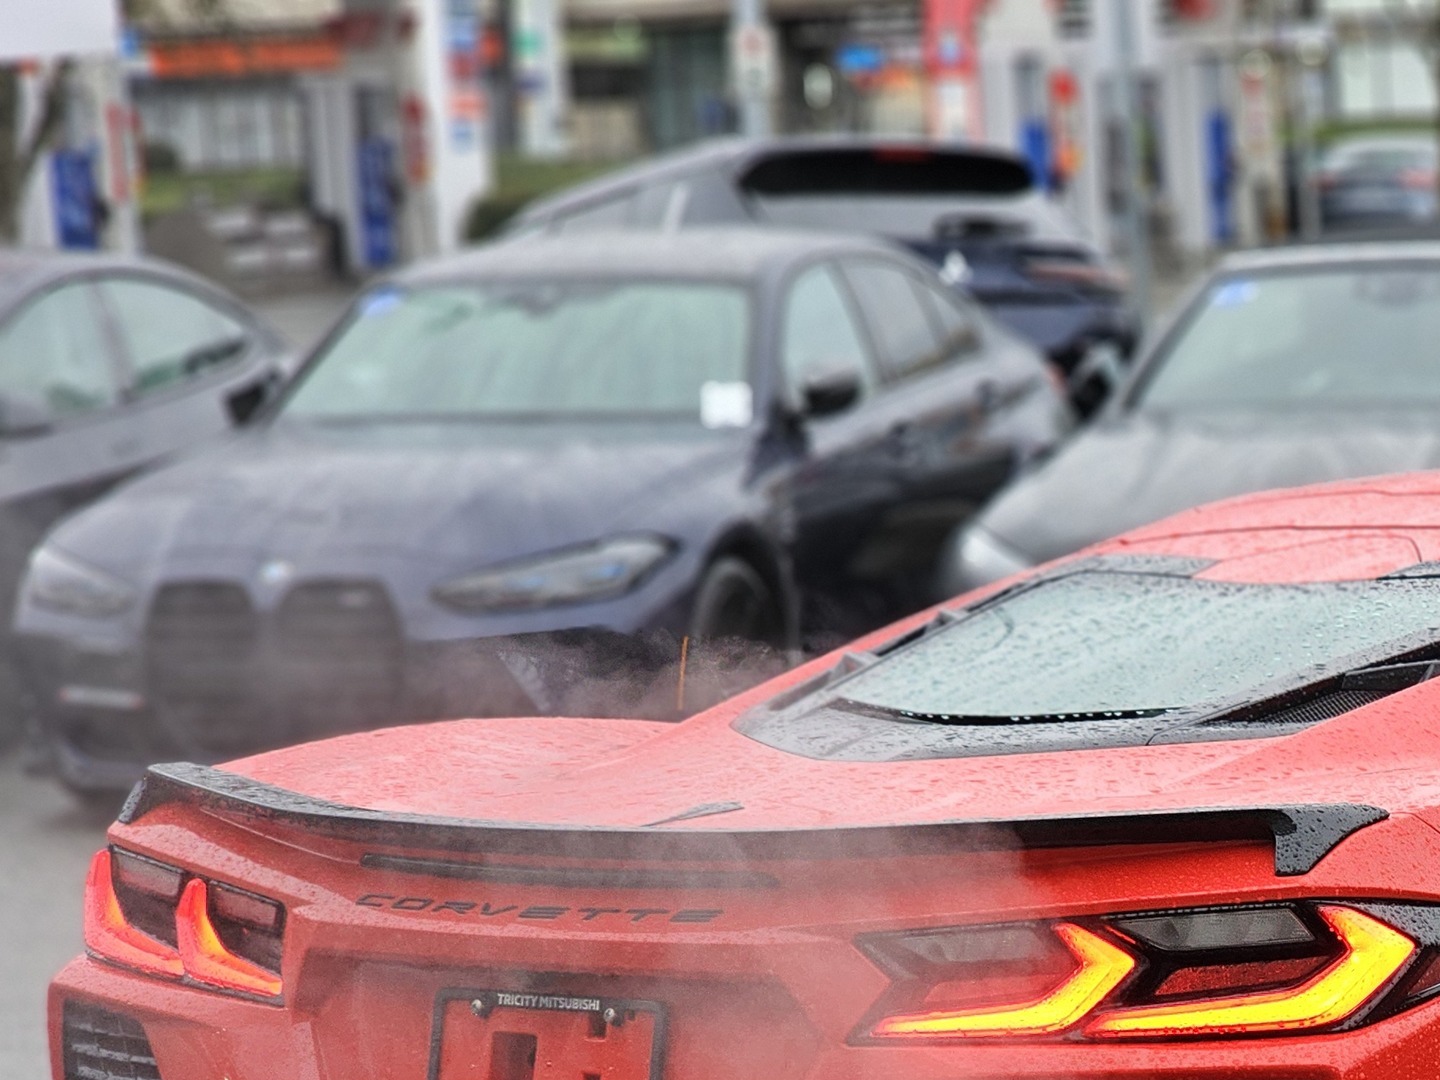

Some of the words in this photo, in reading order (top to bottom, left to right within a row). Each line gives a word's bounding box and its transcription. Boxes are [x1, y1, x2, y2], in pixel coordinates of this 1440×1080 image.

[355, 893, 725, 923] CORVETTE
[497, 993, 538, 1007] TRICITY
[539, 996, 600, 1011] MITSUBISHI
